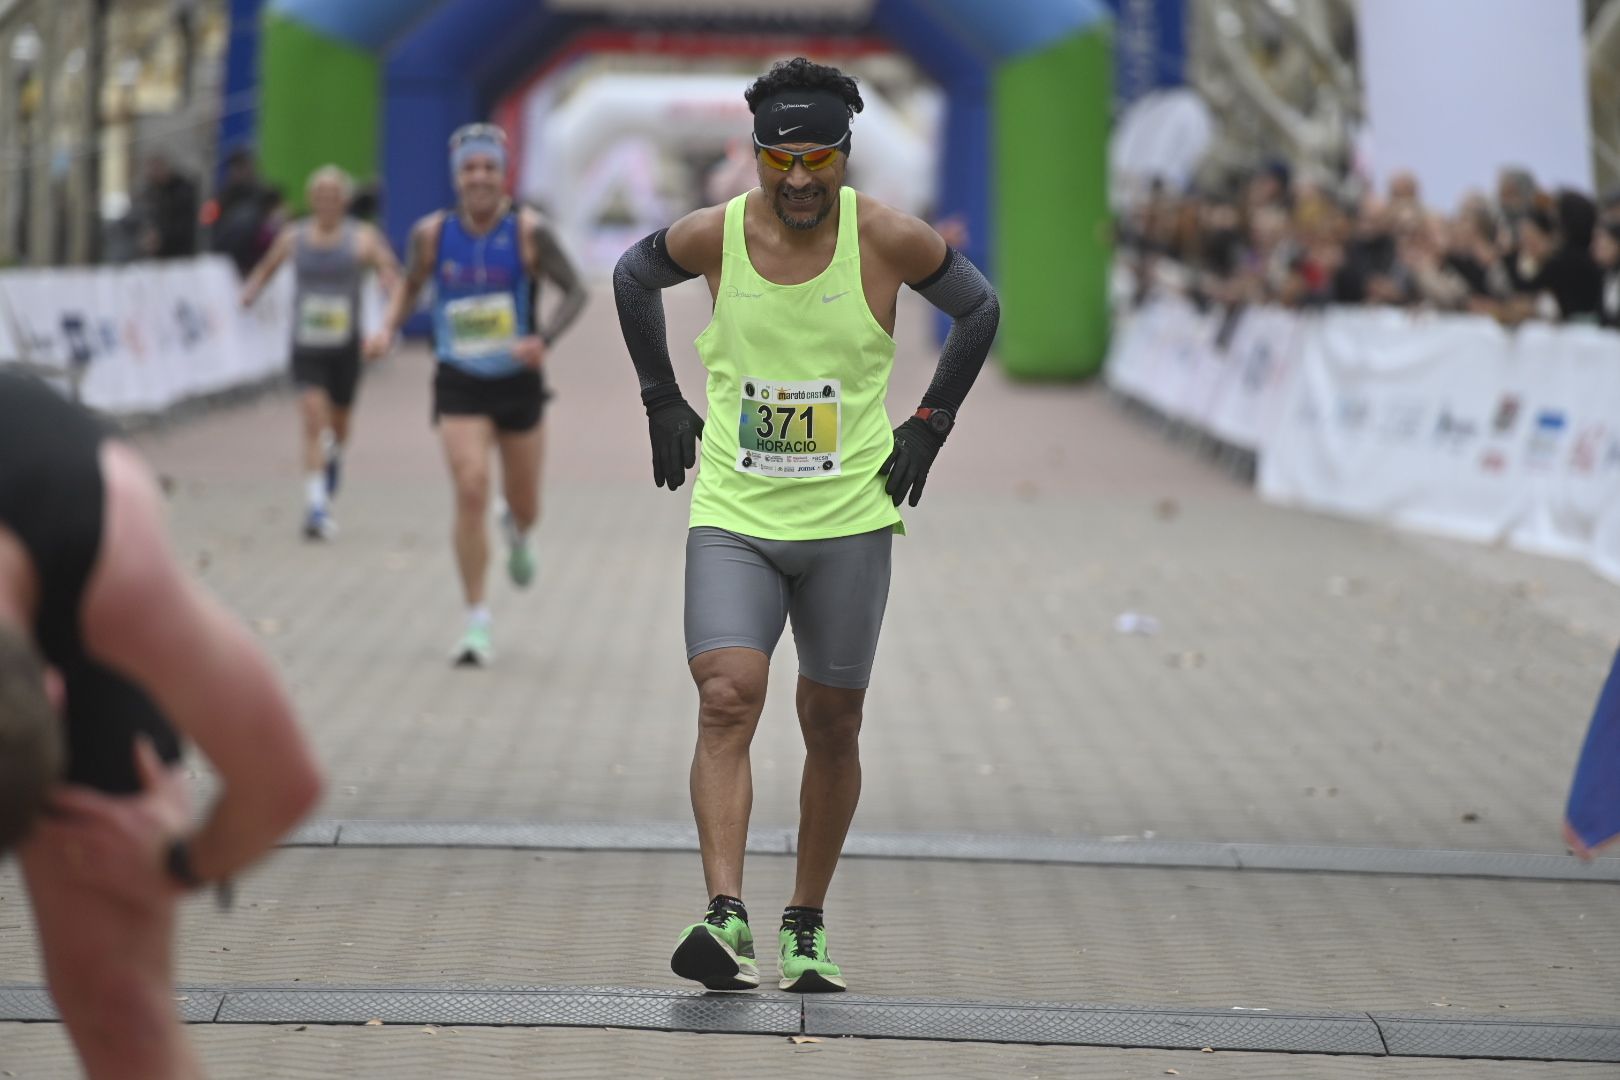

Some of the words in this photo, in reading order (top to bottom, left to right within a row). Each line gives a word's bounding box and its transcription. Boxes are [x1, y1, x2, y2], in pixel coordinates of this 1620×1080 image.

[778, 391, 805, 400] marató
[756, 404, 813, 440] 371
[756, 439, 817, 453] HORACIO
